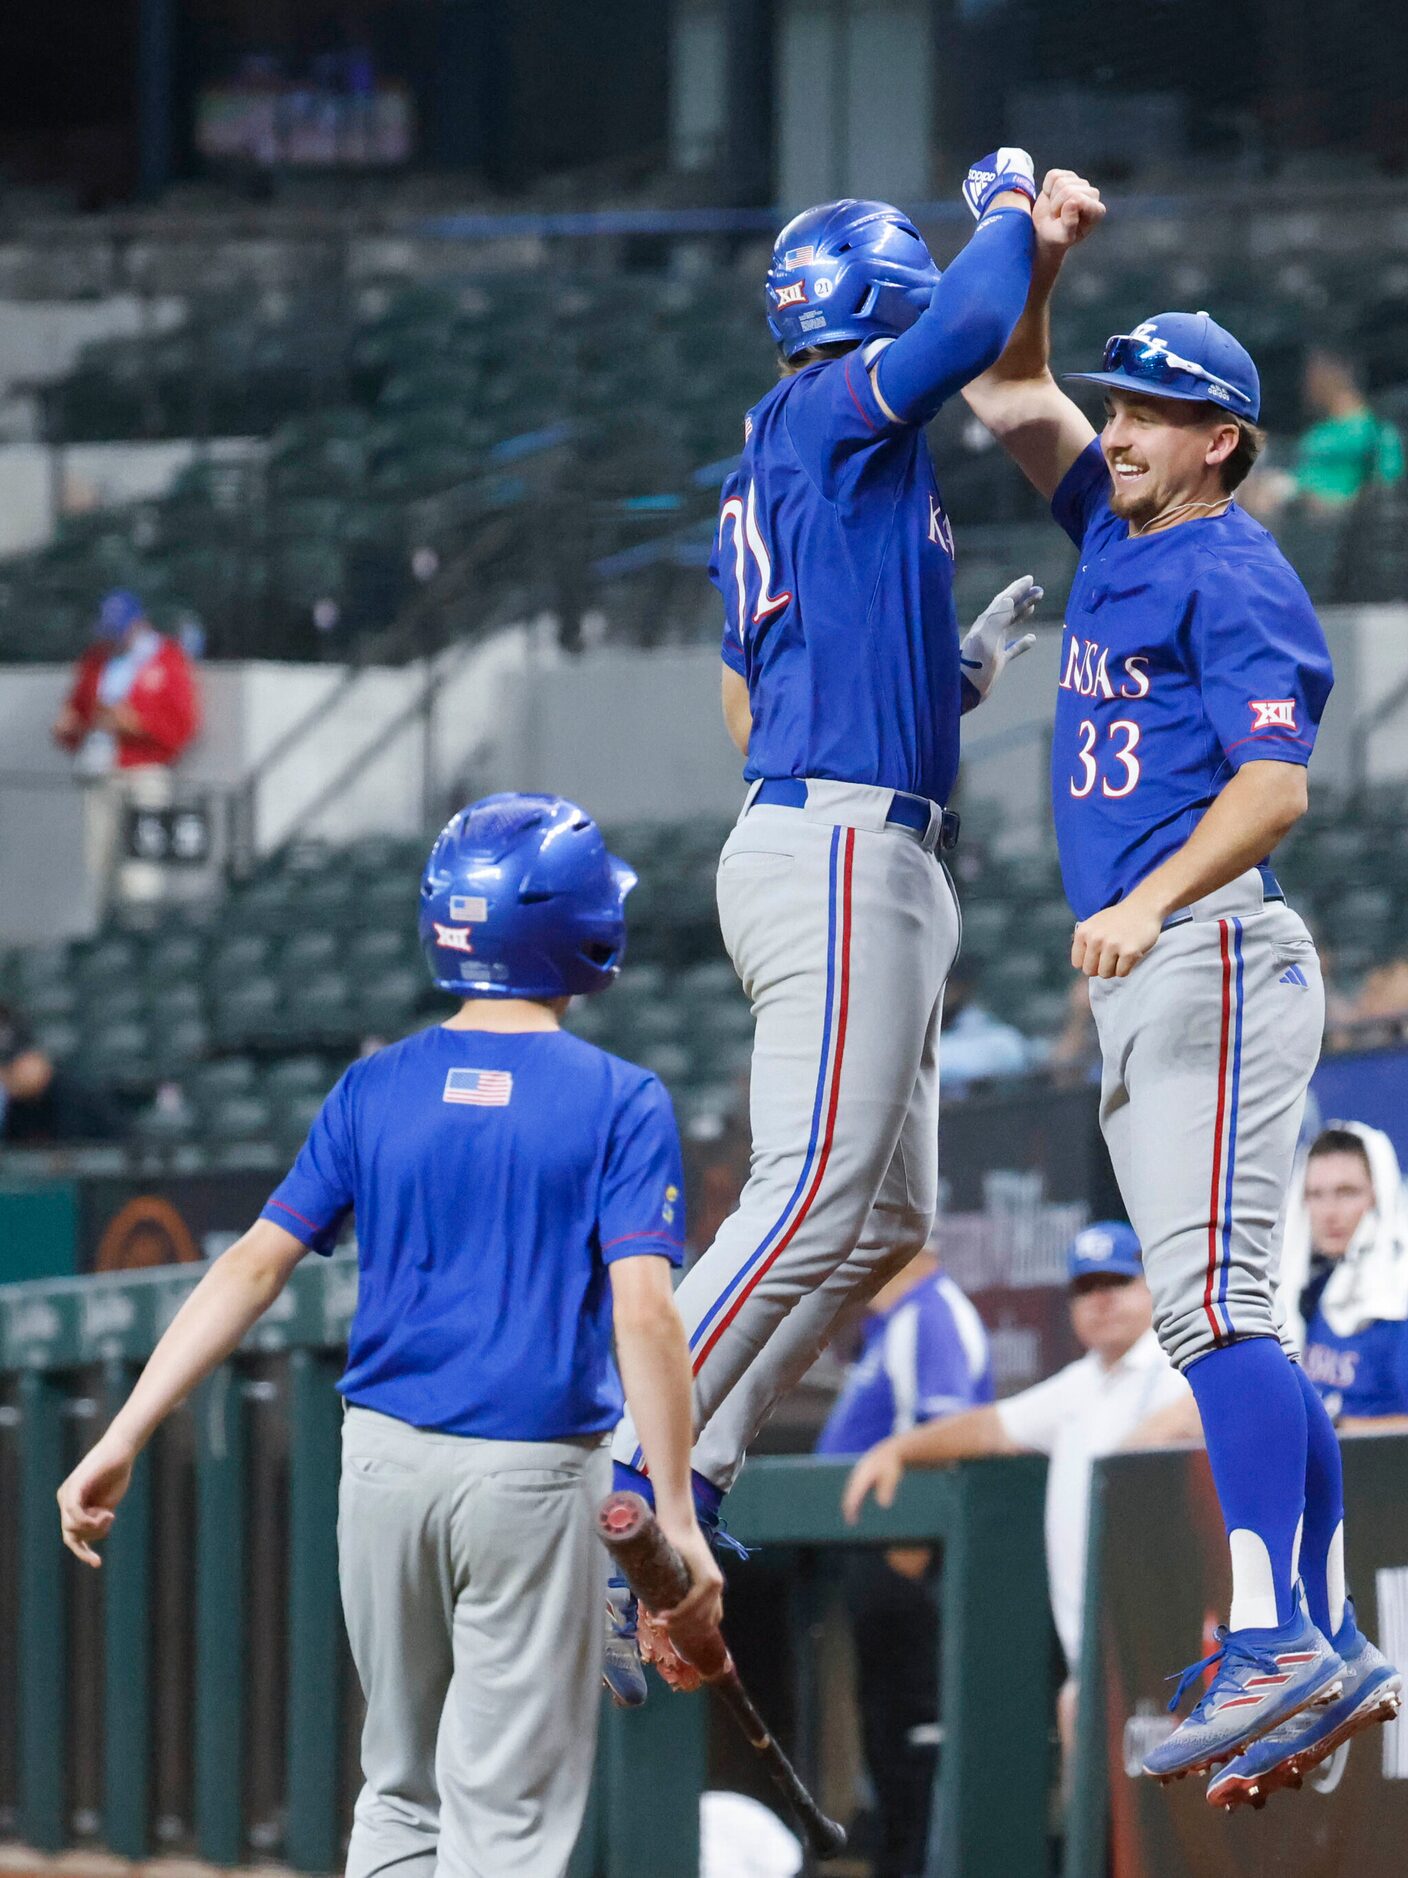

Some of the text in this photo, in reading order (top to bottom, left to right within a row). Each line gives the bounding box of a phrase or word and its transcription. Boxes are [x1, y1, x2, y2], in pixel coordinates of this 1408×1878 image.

[1207, 387, 1230, 401] adidas
[1059, 635, 1150, 700] NSAS
[1070, 720, 1142, 798] 33
